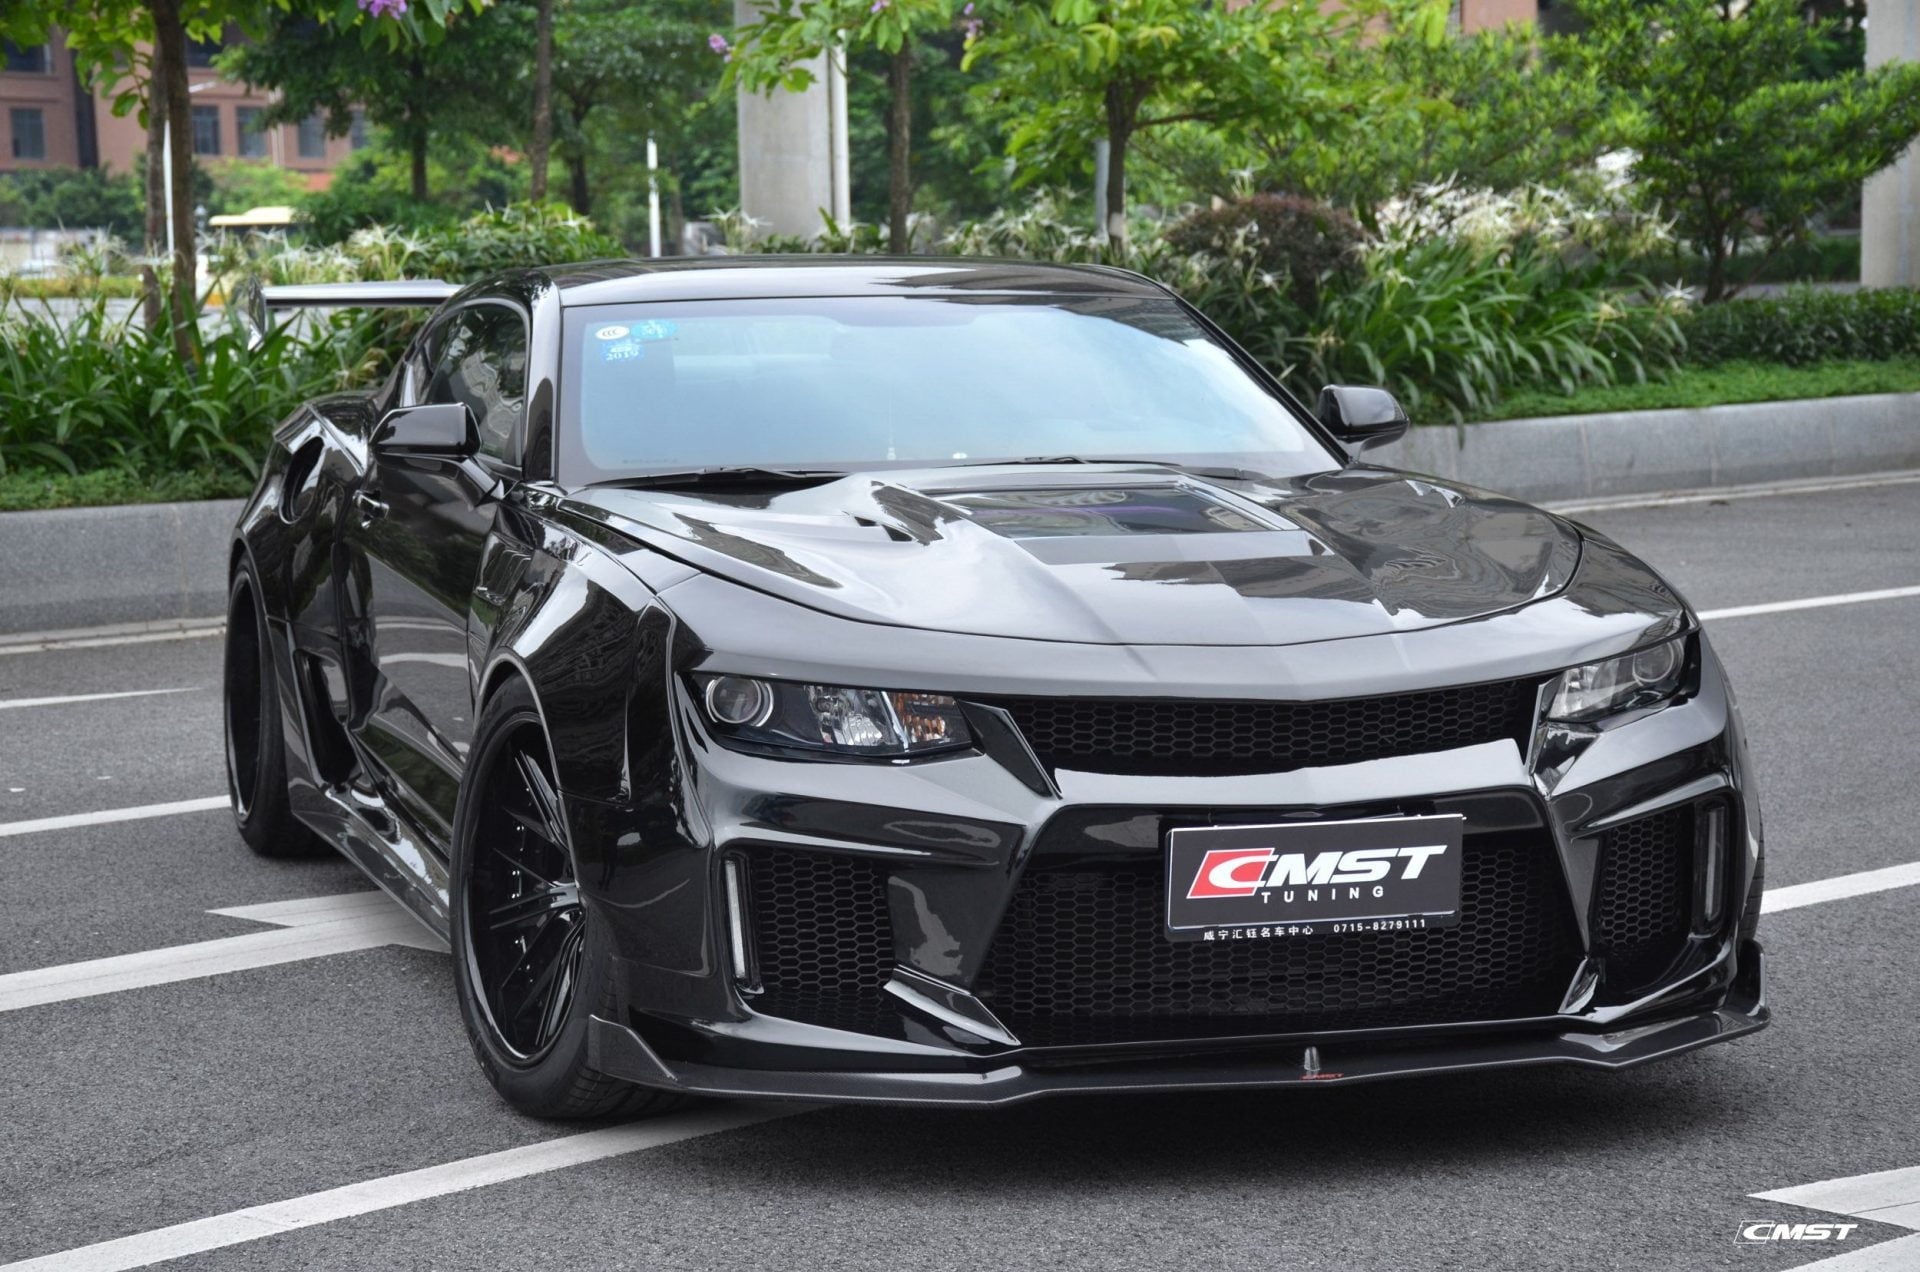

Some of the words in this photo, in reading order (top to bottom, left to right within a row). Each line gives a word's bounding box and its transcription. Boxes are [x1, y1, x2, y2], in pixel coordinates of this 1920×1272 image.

[1207, 845, 1448, 889] CMST
[1261, 885, 1384, 904] TUNING
[1333, 918, 1425, 933] 0715-8279111
